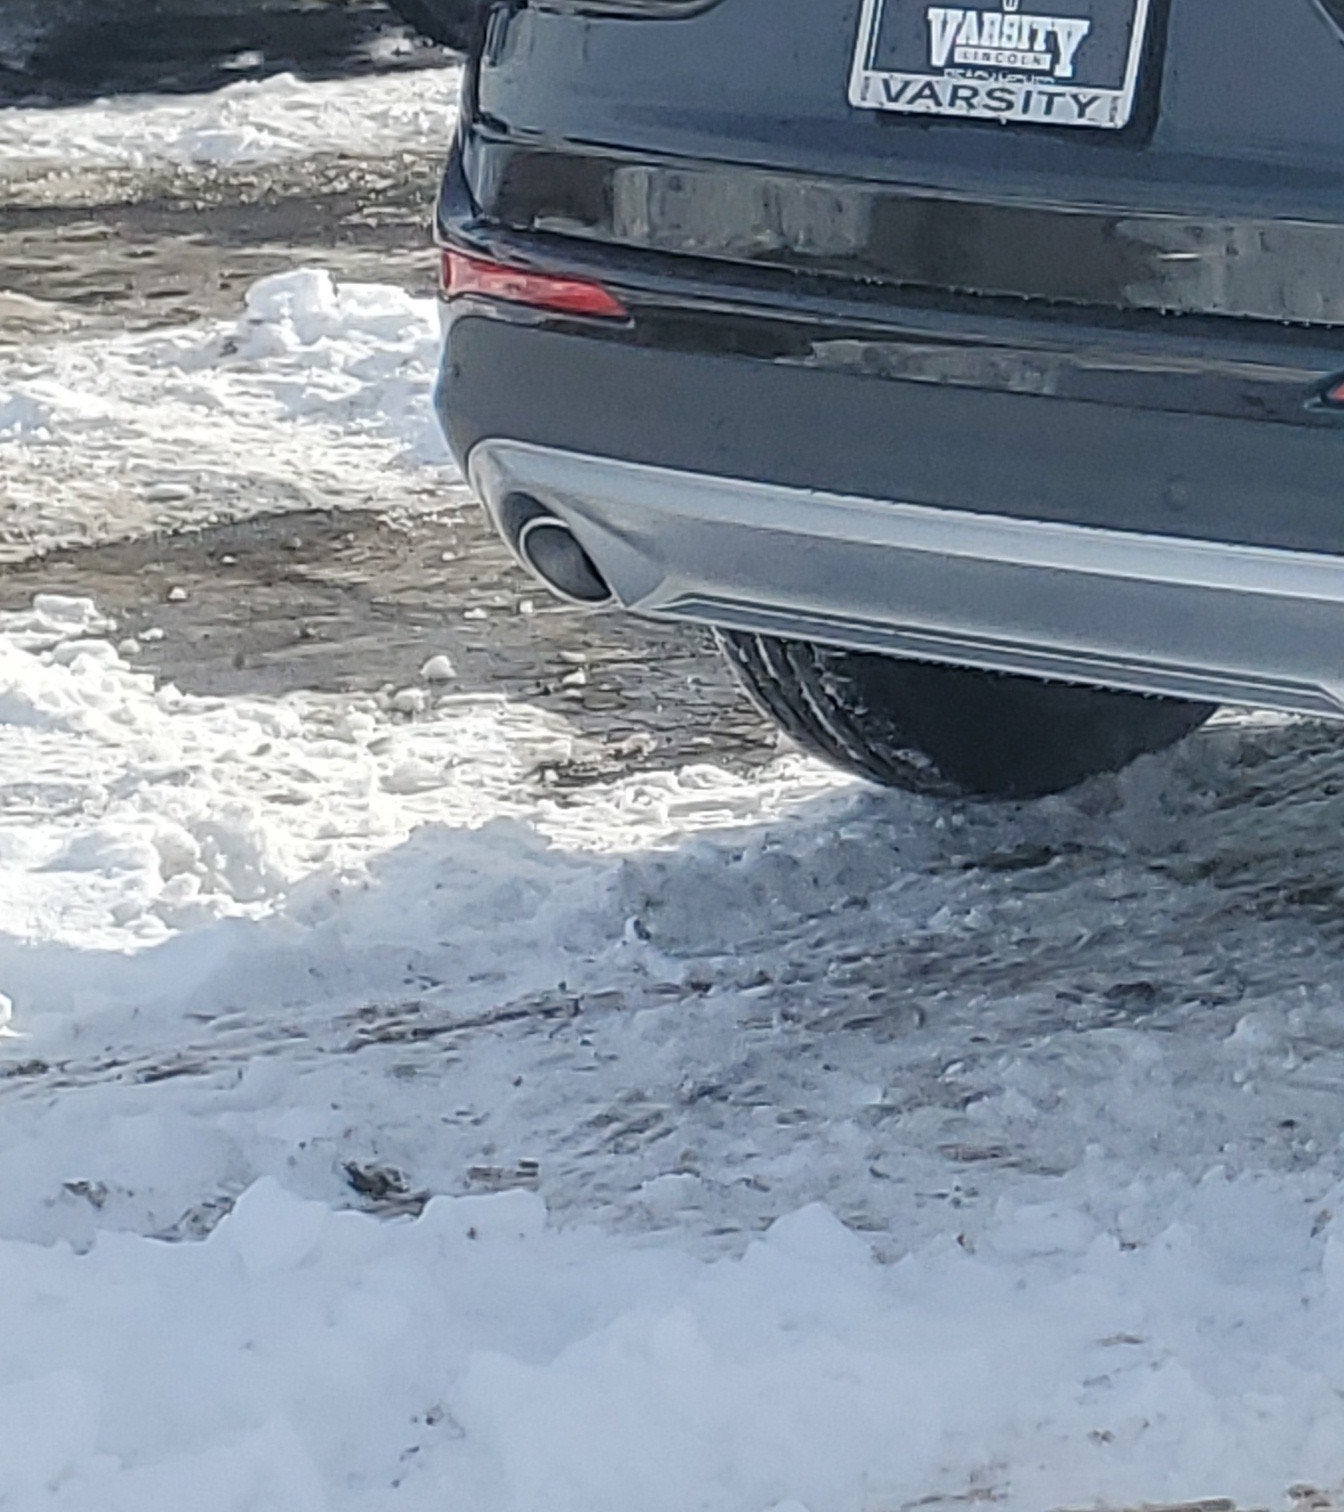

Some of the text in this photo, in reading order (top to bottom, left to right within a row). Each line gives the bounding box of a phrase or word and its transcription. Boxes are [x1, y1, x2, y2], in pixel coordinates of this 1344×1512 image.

[927, 7, 1090, 77] VARSITY
[963, 52, 1041, 65] LINCOLN
[882, 78, 1101, 118] VARSITY
